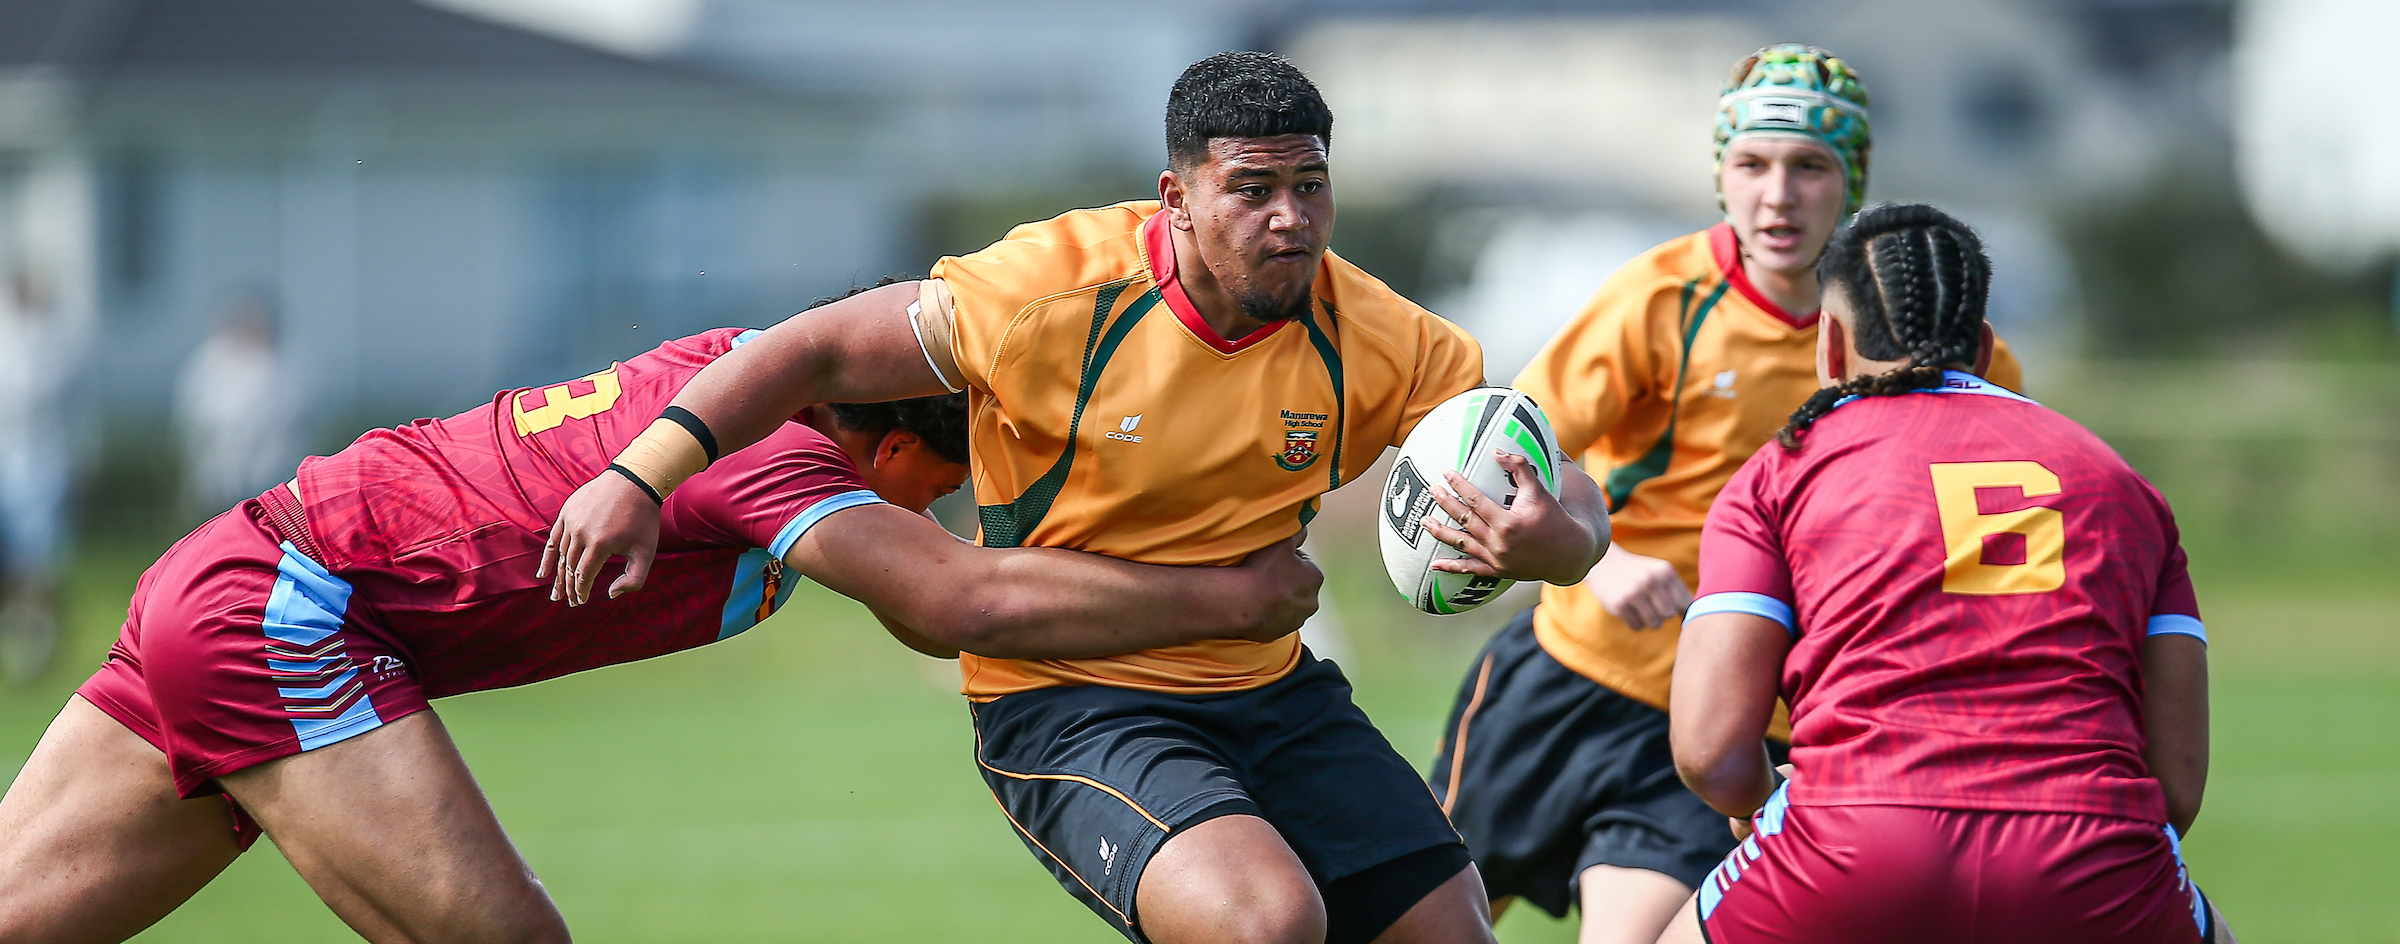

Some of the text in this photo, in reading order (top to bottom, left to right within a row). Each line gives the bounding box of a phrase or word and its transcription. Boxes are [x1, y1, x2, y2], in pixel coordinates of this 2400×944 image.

[1280, 409, 1329, 421] Manurewa
[1284, 419, 1324, 428] High School
[1105, 431, 1144, 444] CODE
[1929, 459, 2067, 597] 6
[1104, 843, 1119, 876] CODE
